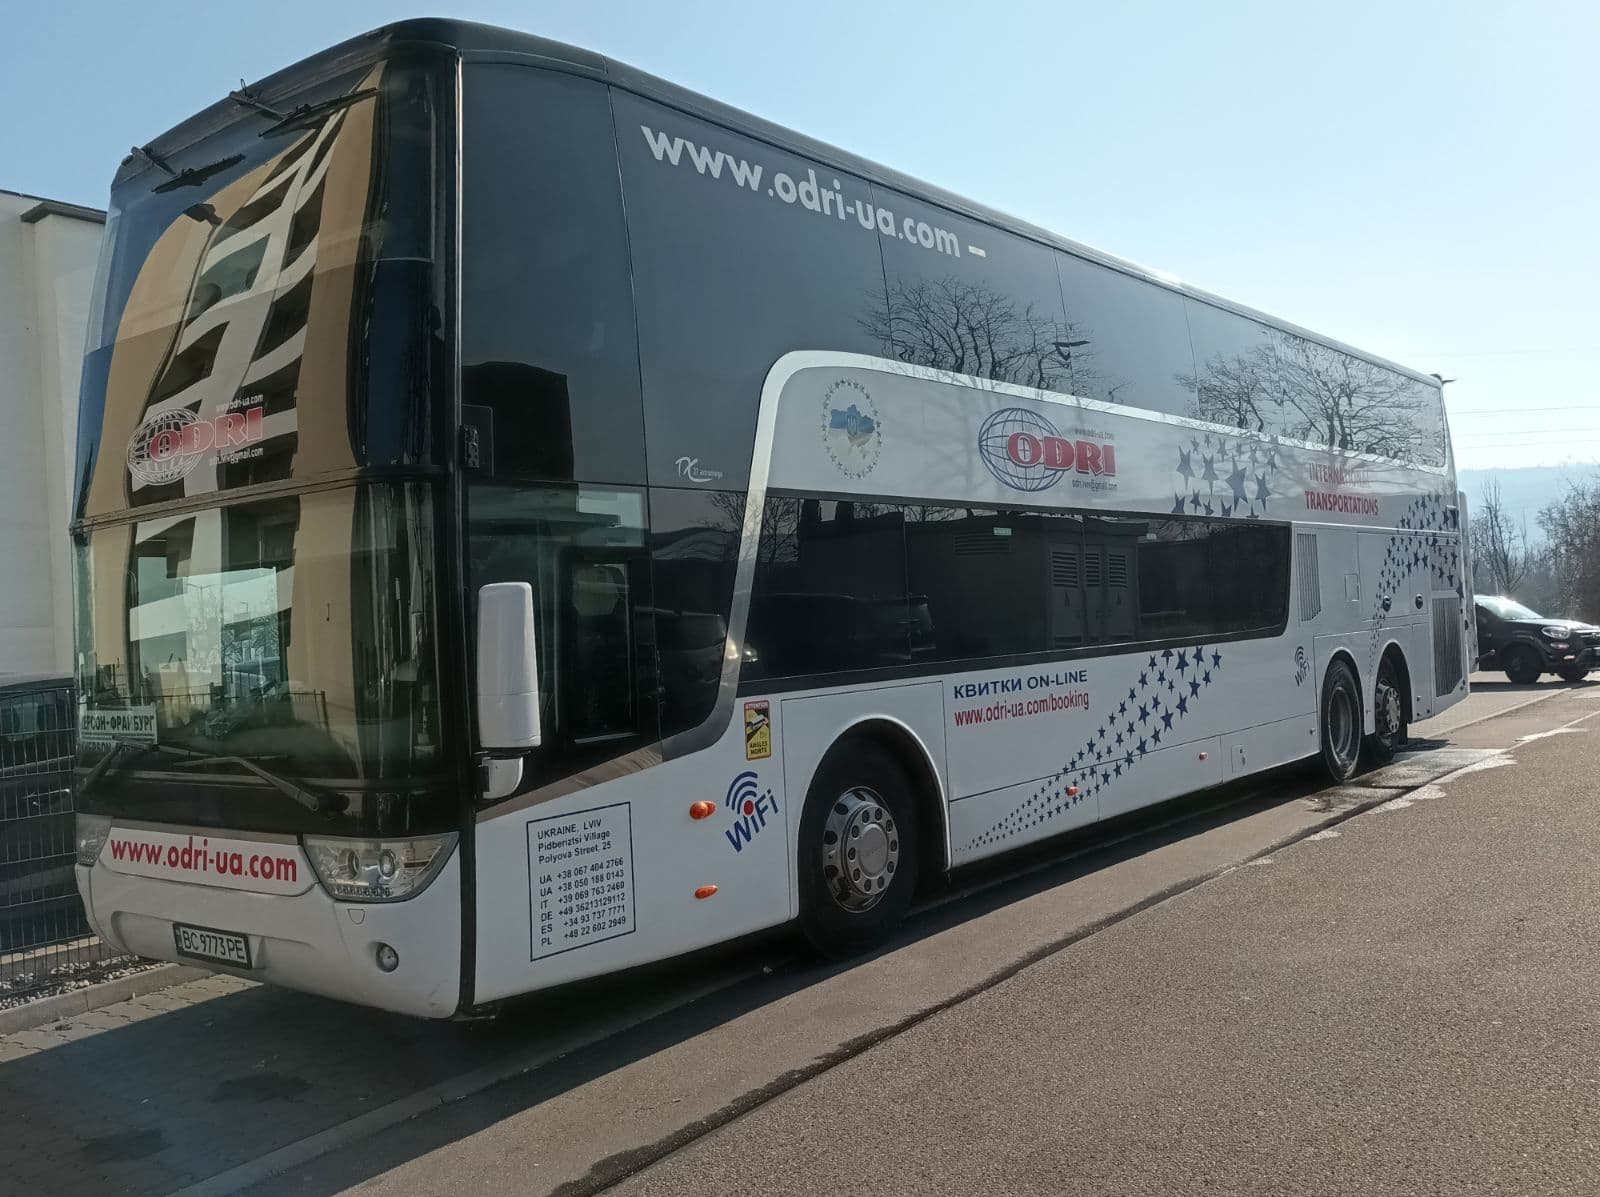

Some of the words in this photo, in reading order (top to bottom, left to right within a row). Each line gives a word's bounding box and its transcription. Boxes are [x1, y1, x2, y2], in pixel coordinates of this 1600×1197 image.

[640, 125, 961, 257] www.odri-ua.com
[151, 406, 264, 462] ODRI
[1007, 431, 1117, 476] ODRI
[1304, 490, 1379, 516] TRANSPORTATIONS
[954, 678, 1022, 699] КВИТКИ
[1026, 670, 1088, 690] ON-LINE
[954, 690, 1090, 727] www.odri-ua.com/booking
[583, 818, 602, 830] LVIV
[725, 788, 779, 853] WiFi
[584, 830, 610, 841] Village
[111, 836, 297, 882] www.odri-ua.com
[538, 851, 573, 864] Polyova
[602, 840, 612, 851] 25
[539, 874, 553, 885] UA
[557, 869, 572, 880] +38
[573, 865, 588, 877] 067
[606, 857, 624, 869] 2766
[540, 886, 553, 897] UA
[558, 881, 573, 892] +38
[574, 877, 589, 889] 050
[606, 869, 624, 881] 0143
[540, 899, 549, 910] IT
[558, 893, 573, 904] +39
[574, 889, 589, 901] 069
[591, 886, 605, 897] 763
[541, 911, 554, 923] DE
[558, 906, 574, 916] +49
[541, 923, 553, 935] ES
[563, 917, 579, 928] +34
[580, 913, 590, 924] 93
[592, 908, 607, 920] 737
[608, 904, 625, 917] 7771
[541, 936, 553, 947] PL
[580, 925, 591, 936] 22
[592, 921, 607, 932] 602
